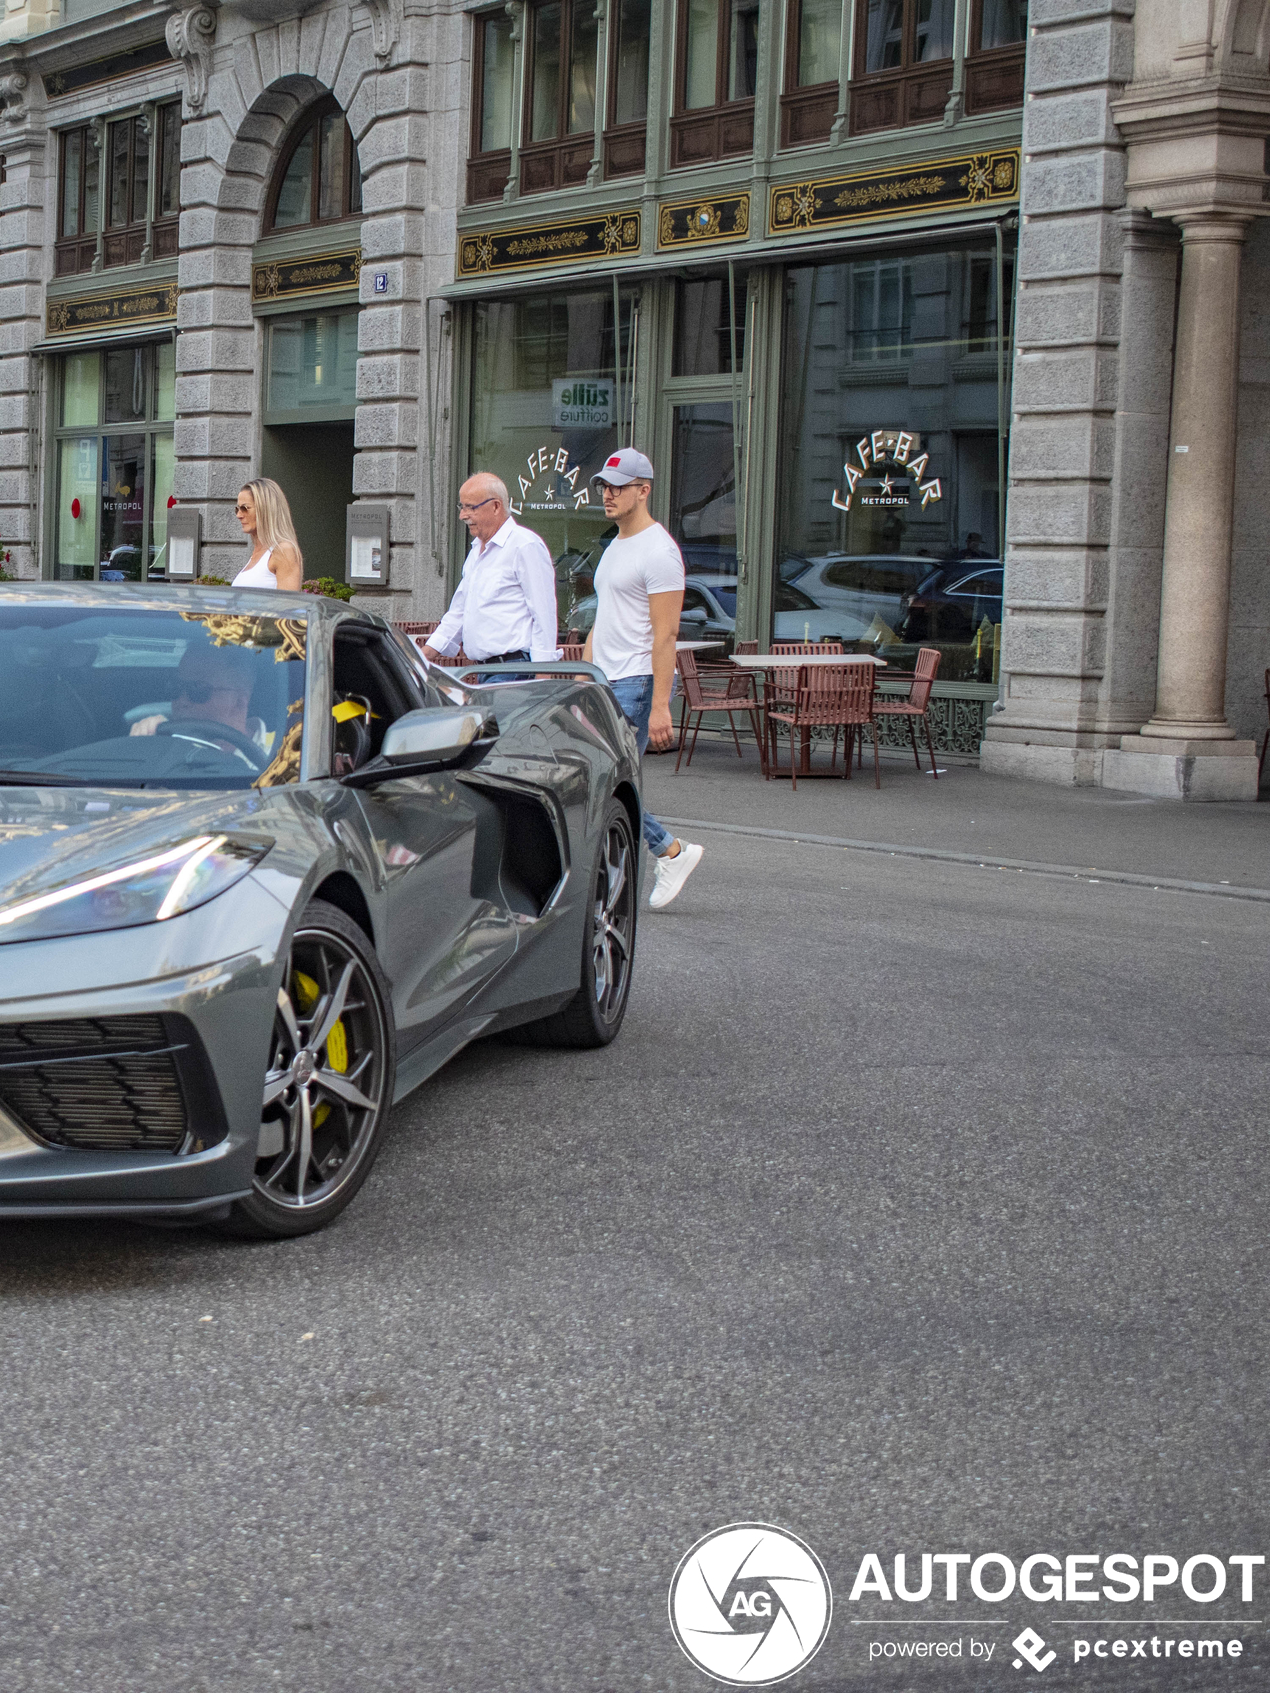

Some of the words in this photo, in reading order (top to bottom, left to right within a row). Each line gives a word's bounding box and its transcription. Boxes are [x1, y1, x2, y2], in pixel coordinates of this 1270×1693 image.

[376, 277, 384, 289] 12
[861, 497, 909, 505] METROPOL
[103, 502, 142, 510] METROPOL
